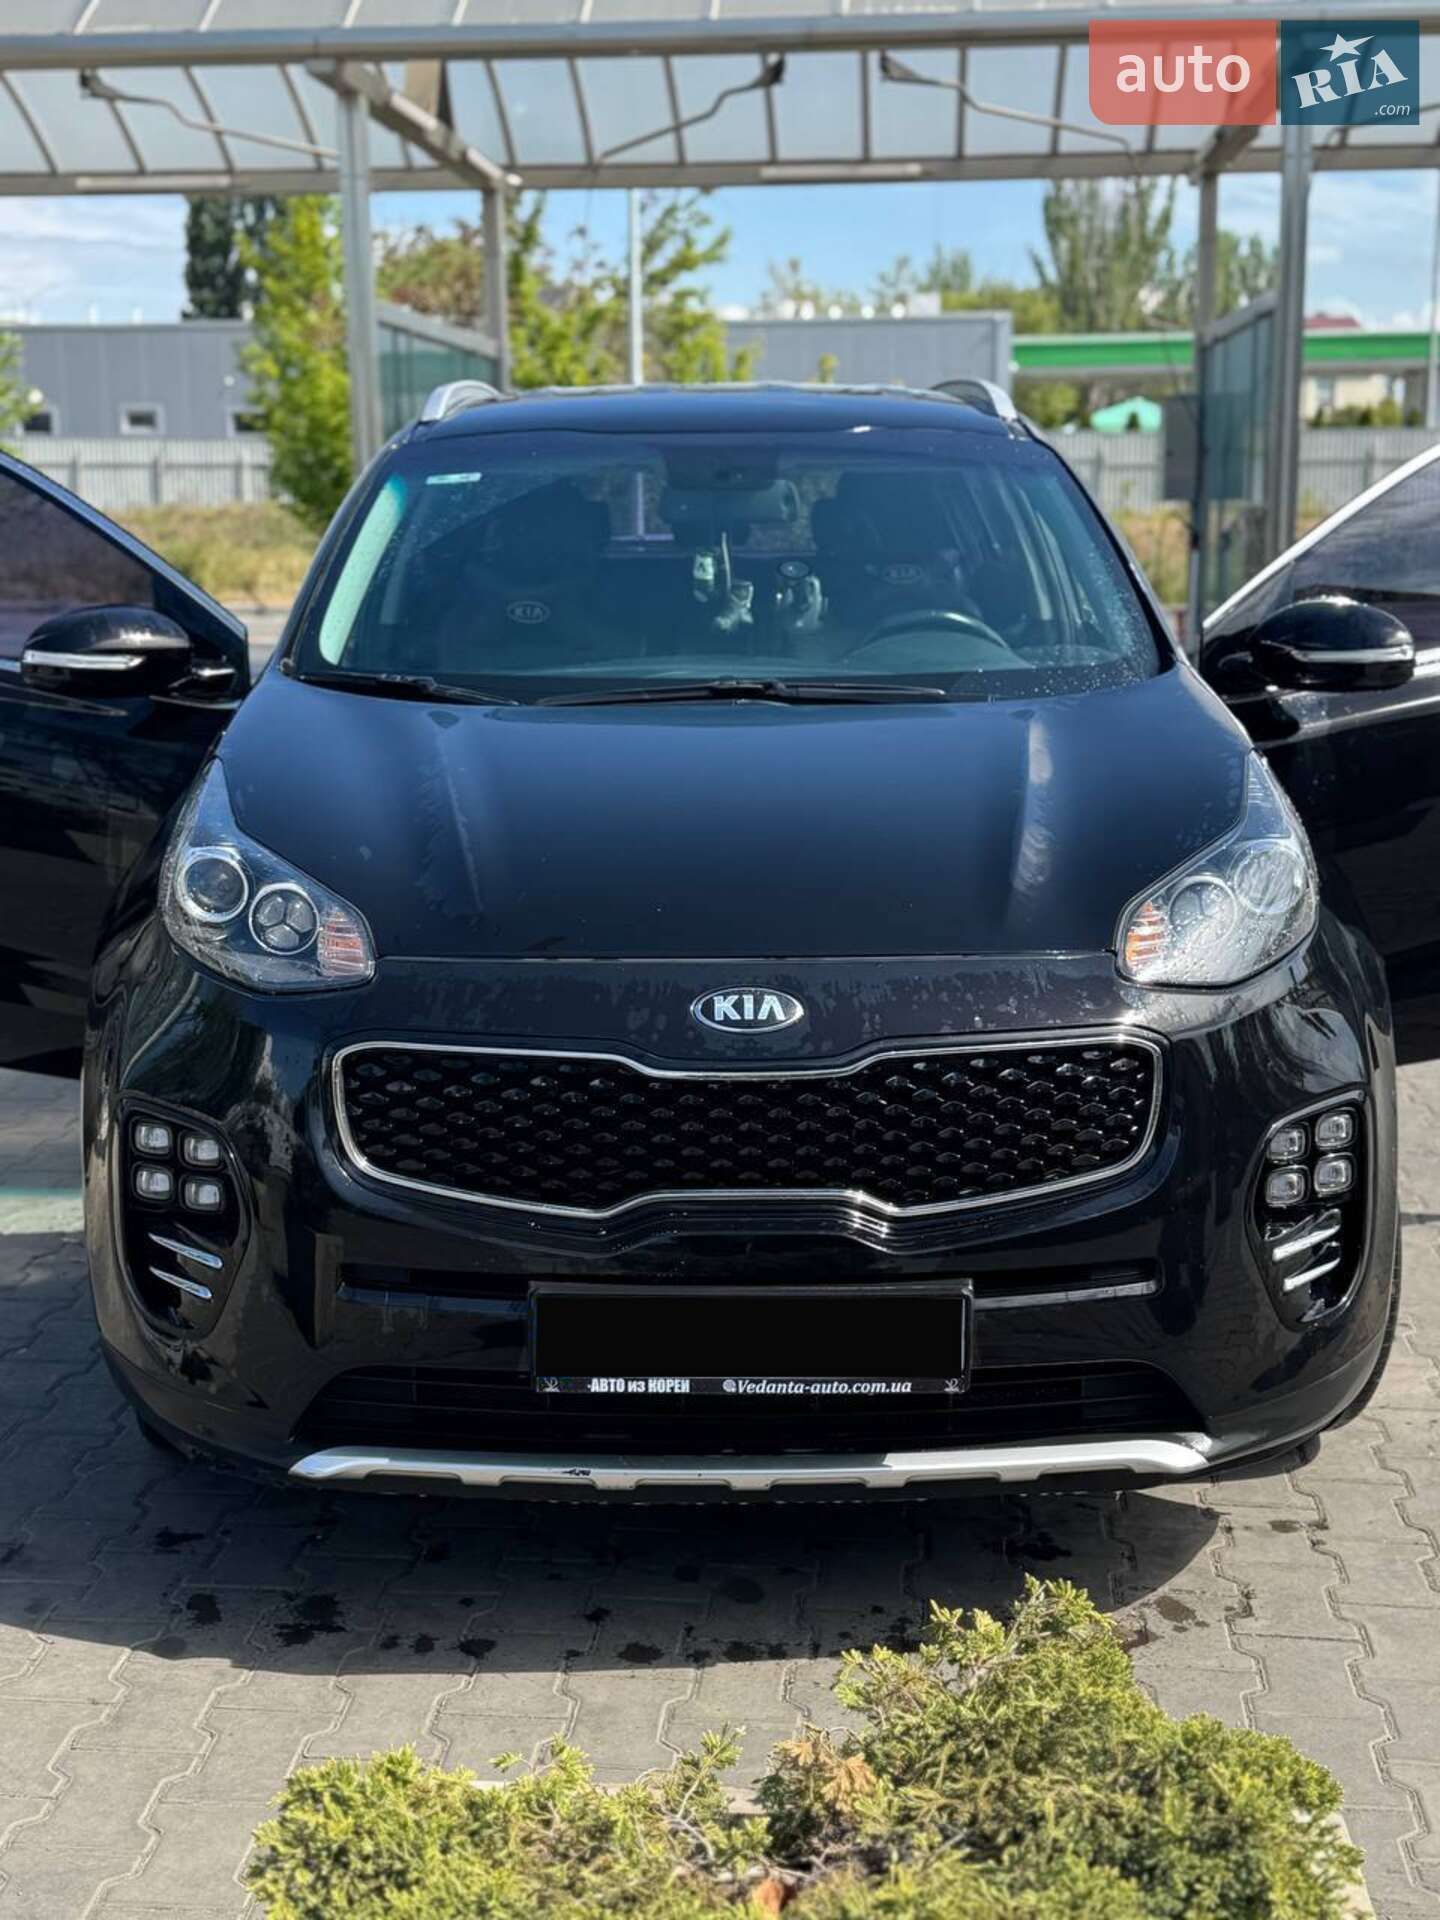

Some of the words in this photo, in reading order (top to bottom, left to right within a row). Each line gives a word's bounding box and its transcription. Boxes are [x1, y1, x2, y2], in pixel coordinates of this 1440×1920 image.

[513, 606, 545, 620] KIA
[713, 994, 786, 1021] KIA
[590, 1378, 625, 1393] АВТО
[627, 1380, 646, 1393] из
